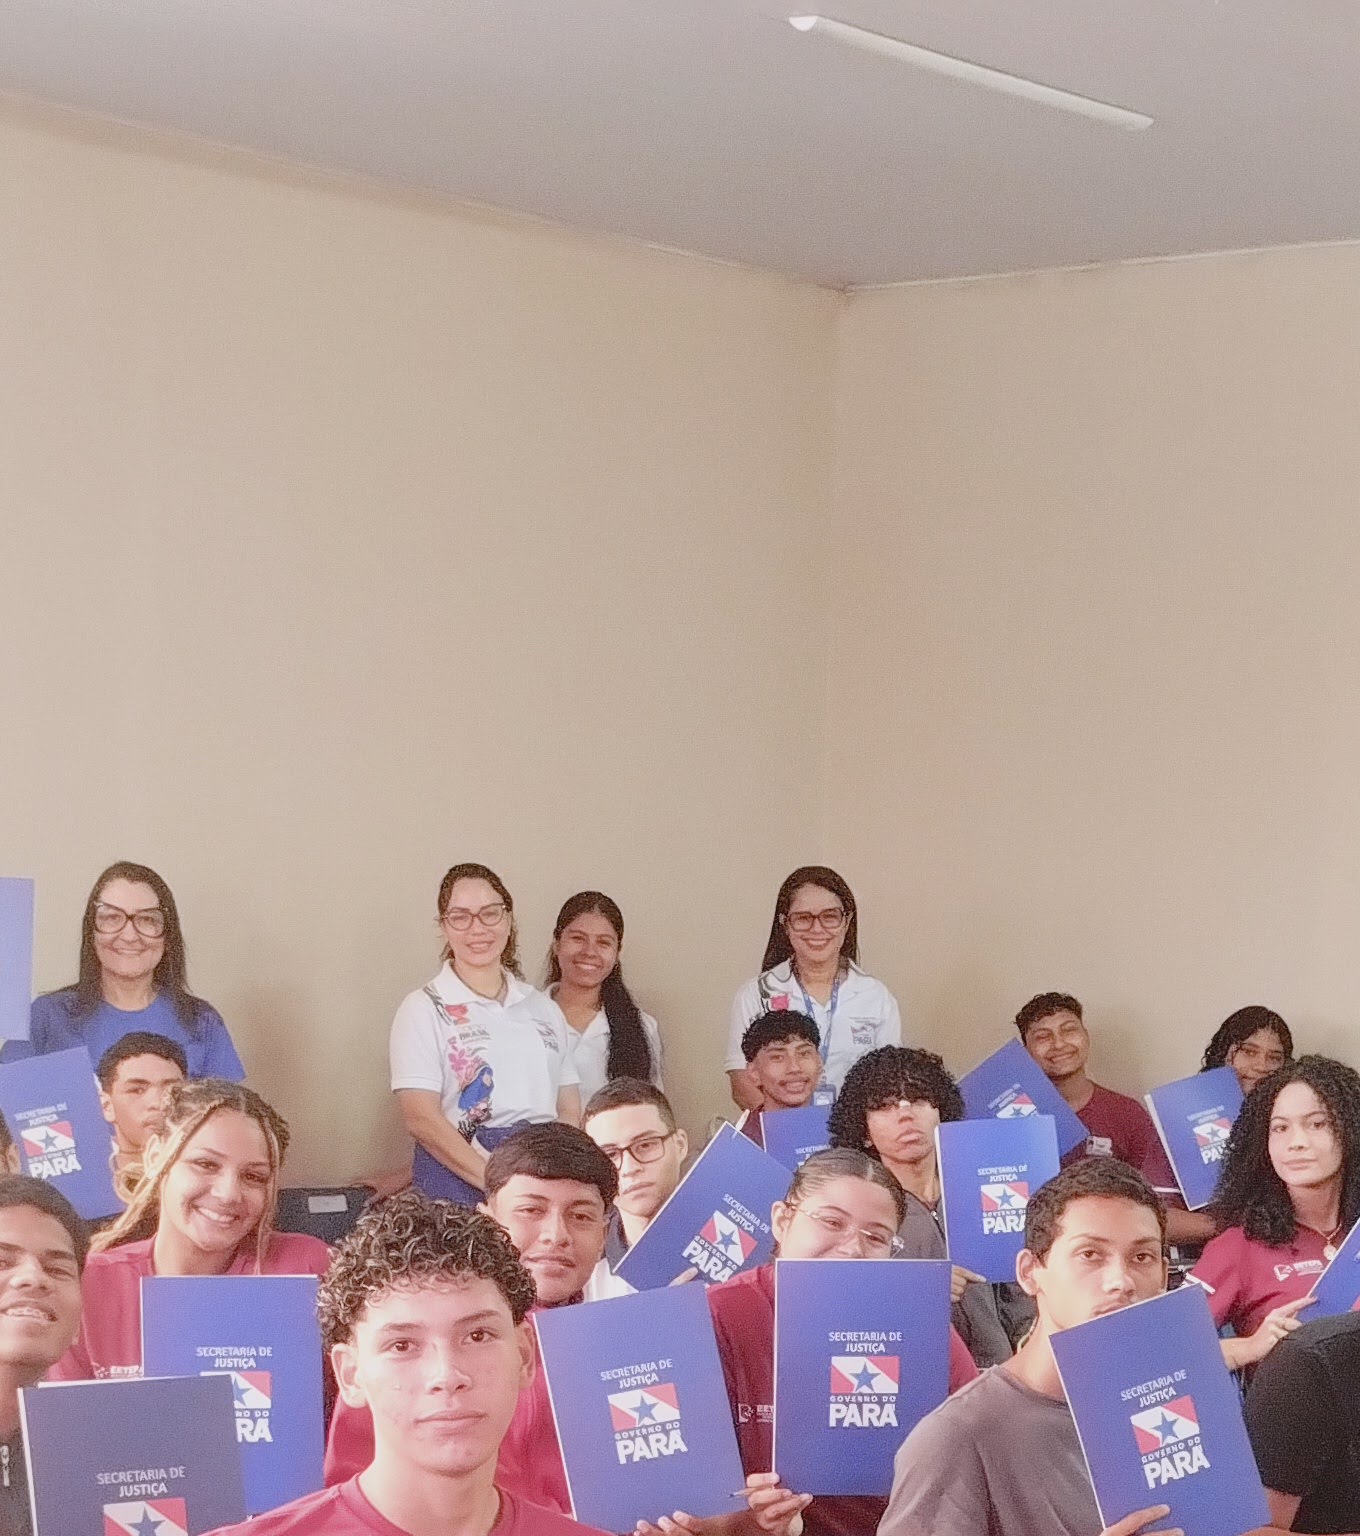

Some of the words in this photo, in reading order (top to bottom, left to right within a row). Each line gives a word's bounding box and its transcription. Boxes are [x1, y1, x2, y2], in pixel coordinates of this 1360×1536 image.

[828, 1332, 887, 1341] SECRETARIA
[889, 1332, 902, 1341] DE
[196, 1347, 257, 1357] SECRETARIA
[259, 1346, 273, 1356] DE
[845, 1343, 886, 1353] JUSTIÇA
[214, 1358, 256, 1369] JUSTIÇA
[600, 1361, 657, 1382] SECRETARIA
[660, 1359, 673, 1369] DE
[619, 1373, 659, 1389] JUSTIÇA
[1120, 1374, 1173, 1401] SECRETARIA
[1174, 1369, 1187, 1380] DE
[1139, 1387, 1176, 1408] JUSTIÇA
[96, 1466, 168, 1486] SECRETARIA
[170, 1465, 186, 1479] DE
[119, 1481, 169, 1498] JUSTIÇA
